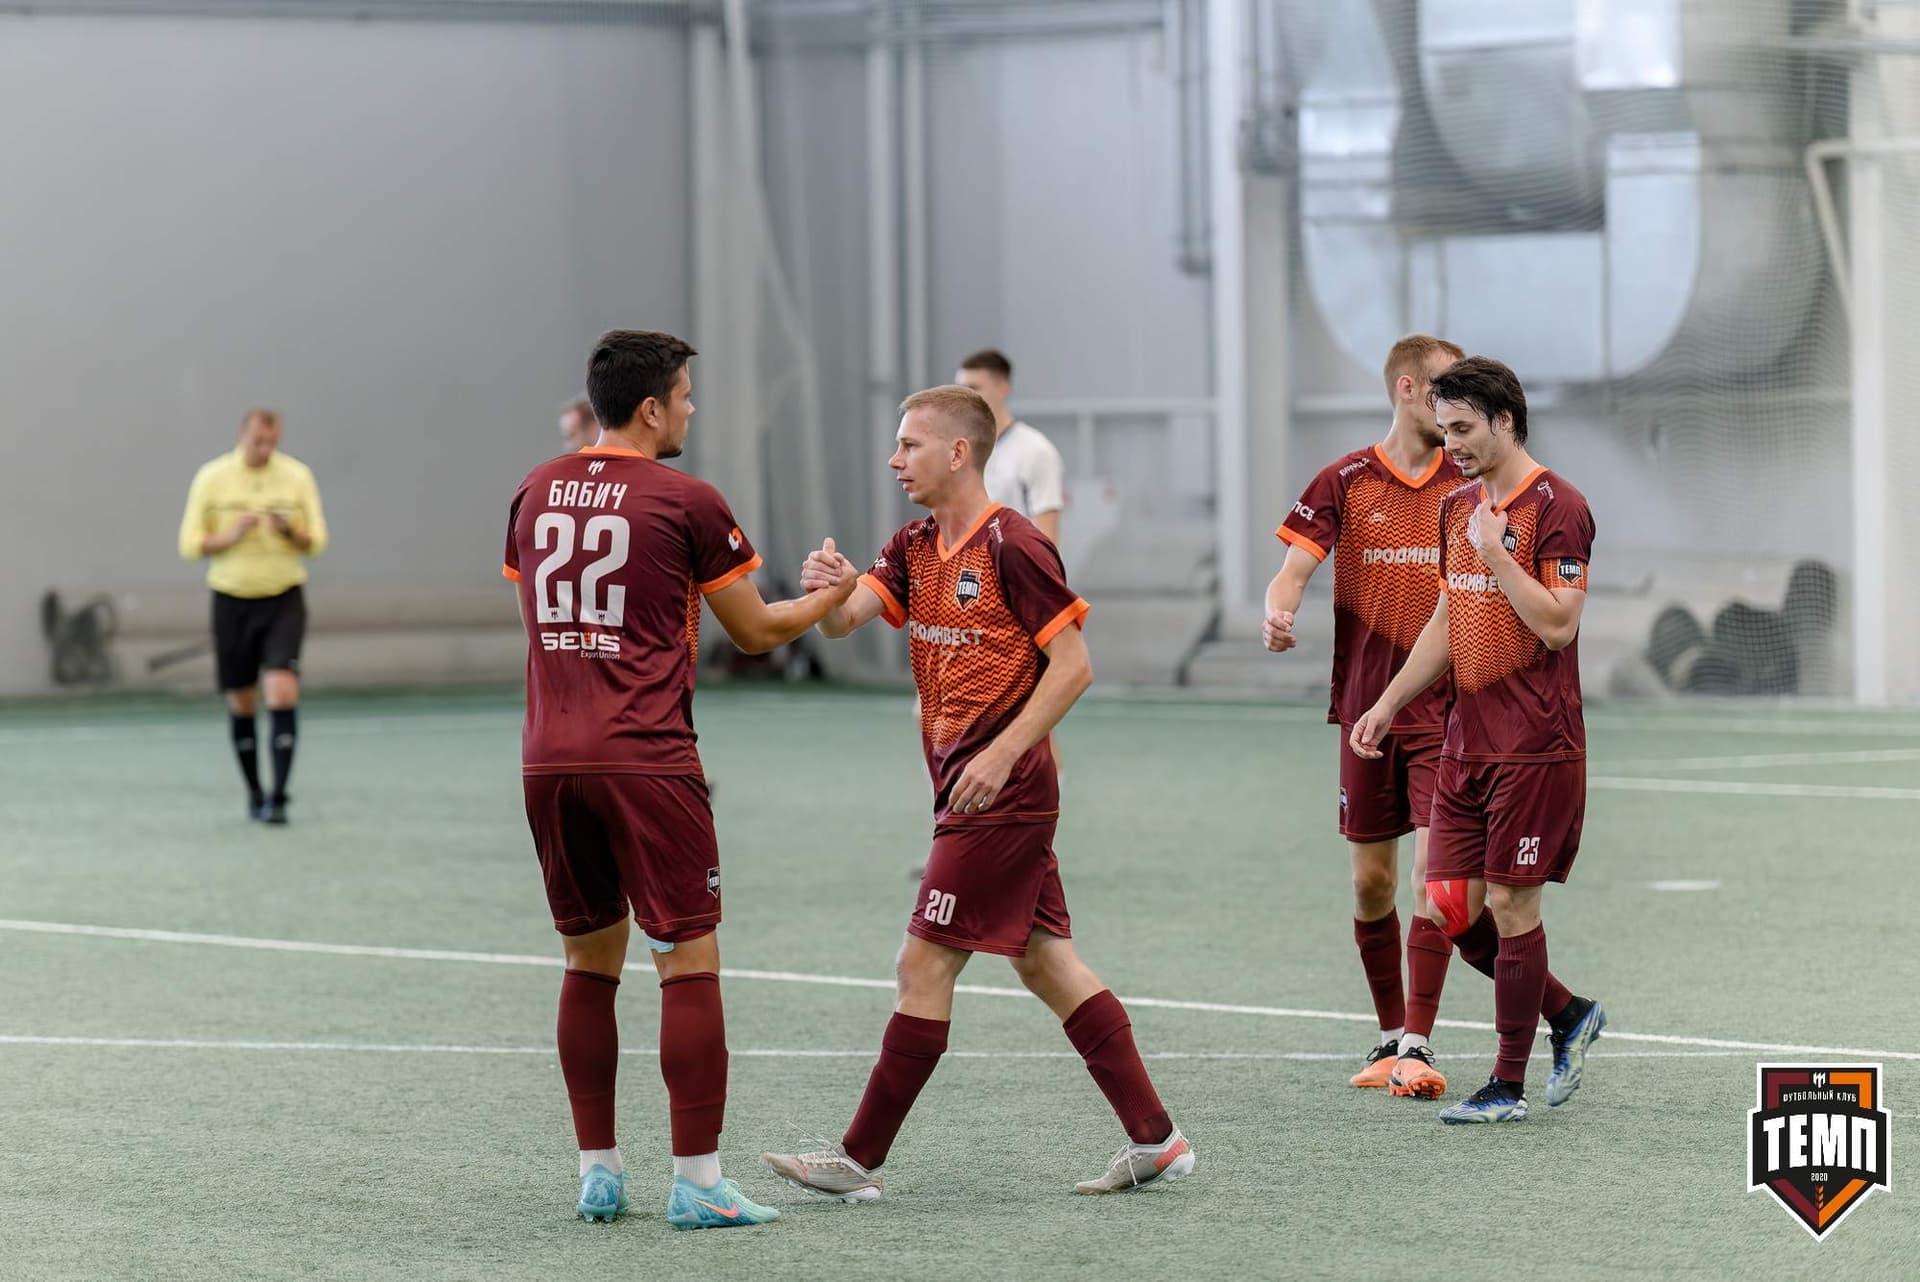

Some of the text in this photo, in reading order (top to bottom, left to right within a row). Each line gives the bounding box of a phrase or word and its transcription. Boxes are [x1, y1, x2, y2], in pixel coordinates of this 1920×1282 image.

[548, 479, 627, 510] БАБИЧ
[1363, 547, 1440, 564] ПРОДИНВ
[534, 512, 631, 627] 22
[1560, 564, 1581, 576] ТЕМП
[957, 581, 979, 597] ТЕМП
[541, 632, 620, 652] SEUS
[599, 651, 620, 660] Union
[1516, 836, 1541, 865] 23
[924, 888, 957, 926] 20
